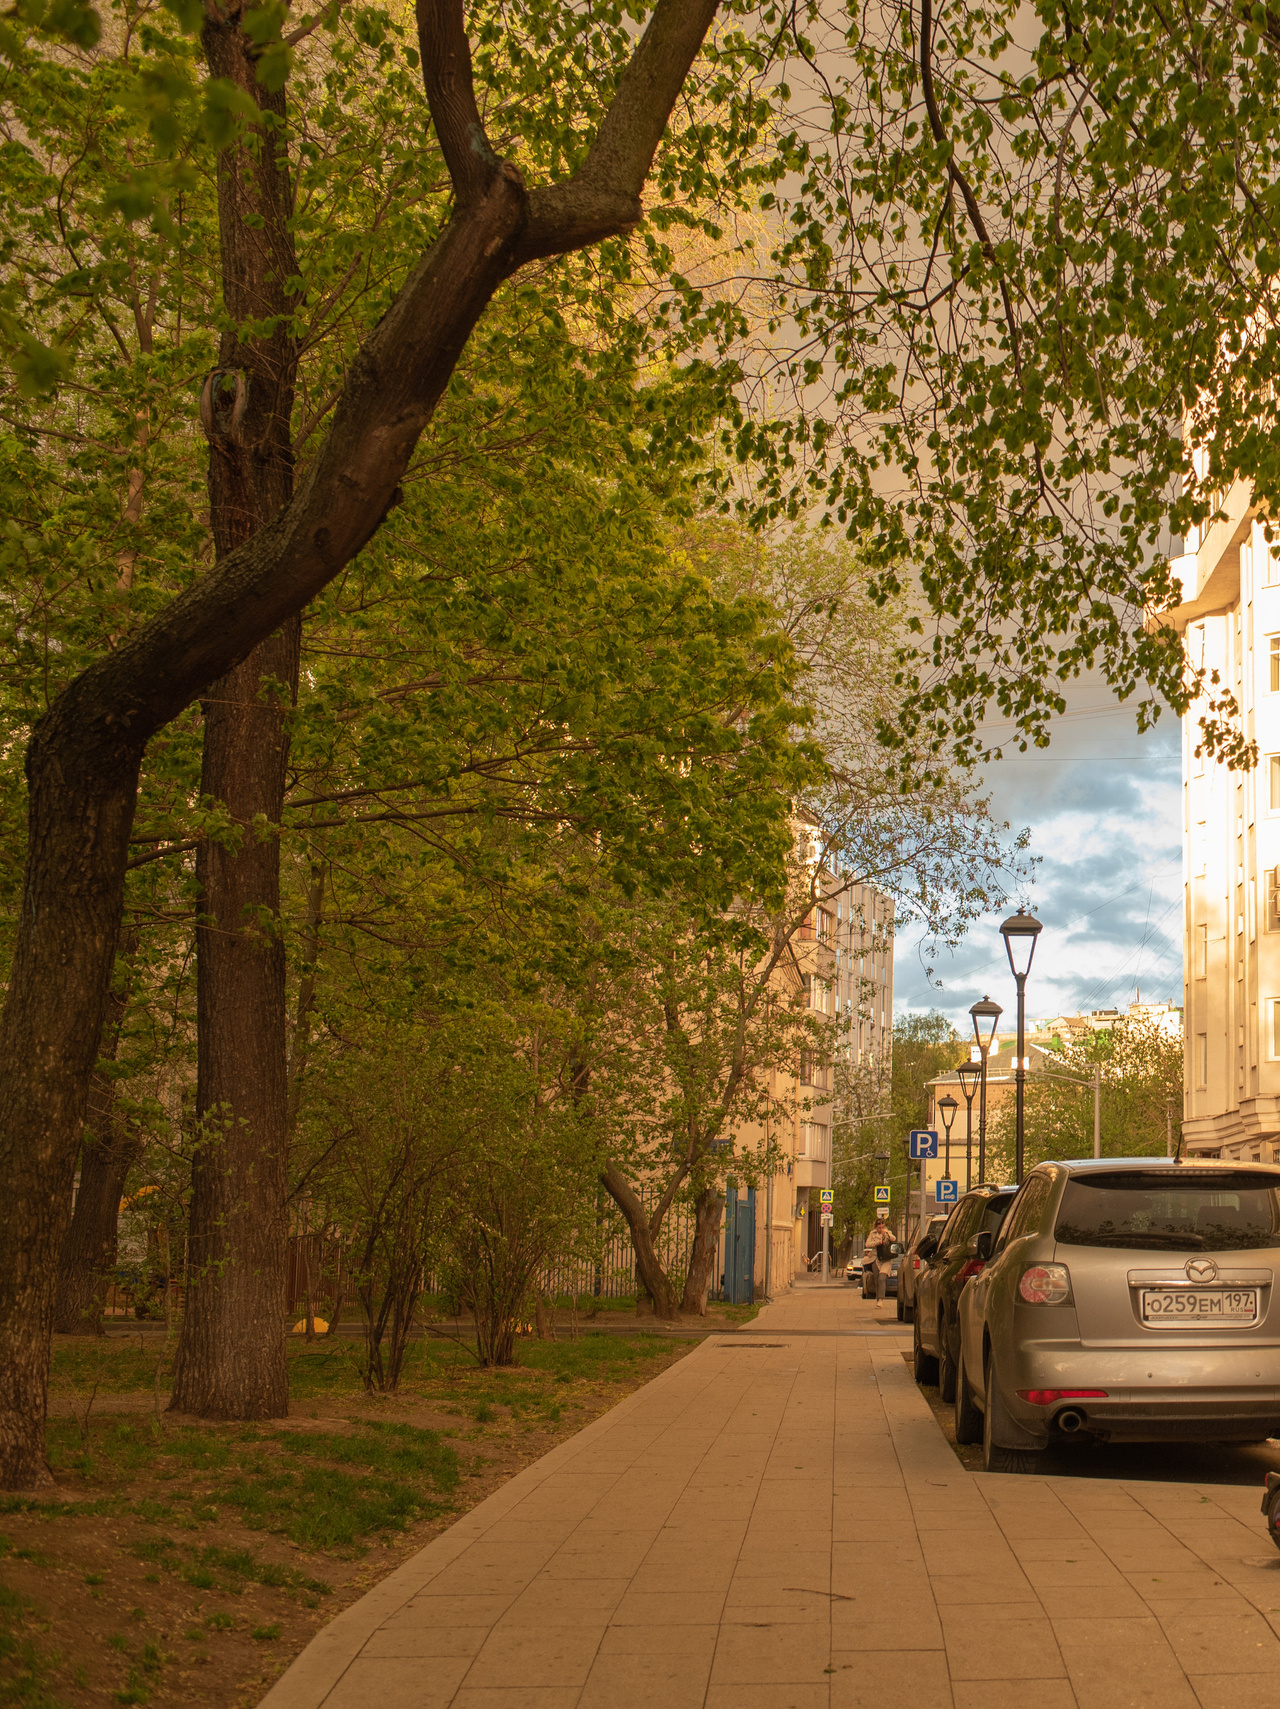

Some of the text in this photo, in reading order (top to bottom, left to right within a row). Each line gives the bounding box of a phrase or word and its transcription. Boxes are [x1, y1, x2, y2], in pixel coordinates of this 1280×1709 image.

[916, 1133, 932, 1156] P
[940, 1182, 953, 1200] P
[1150, 1293, 1250, 1313] О259ЕМ 197
